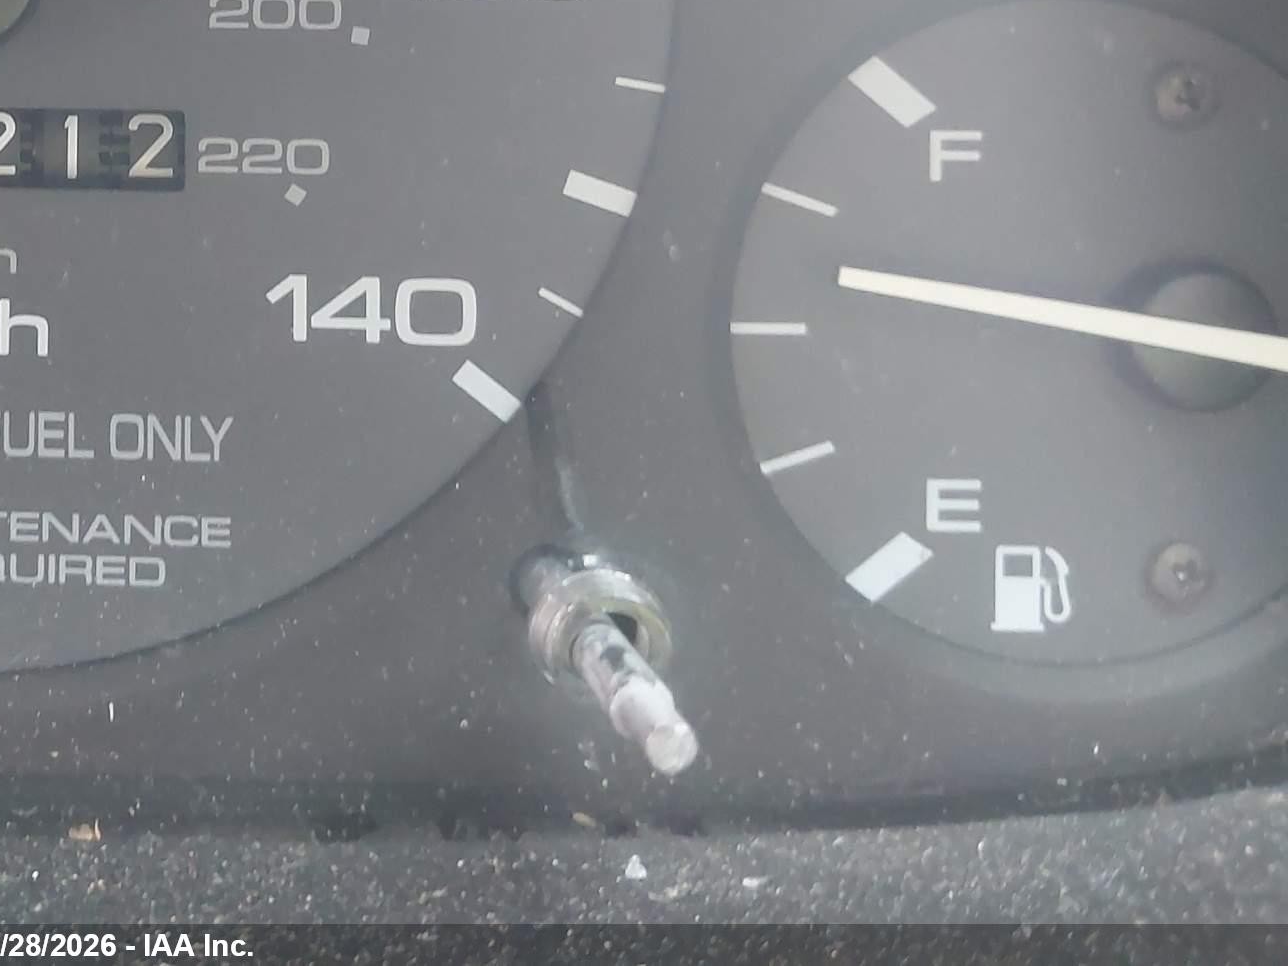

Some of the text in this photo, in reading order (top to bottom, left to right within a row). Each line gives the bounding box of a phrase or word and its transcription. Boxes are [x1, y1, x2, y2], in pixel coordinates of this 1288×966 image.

[198, 138, 329, 174] 220
[930, 130, 982, 181] F
[266, 275, 477, 346] 140
[110, 414, 233, 461] ONLY
[926, 479, 981, 532] E
